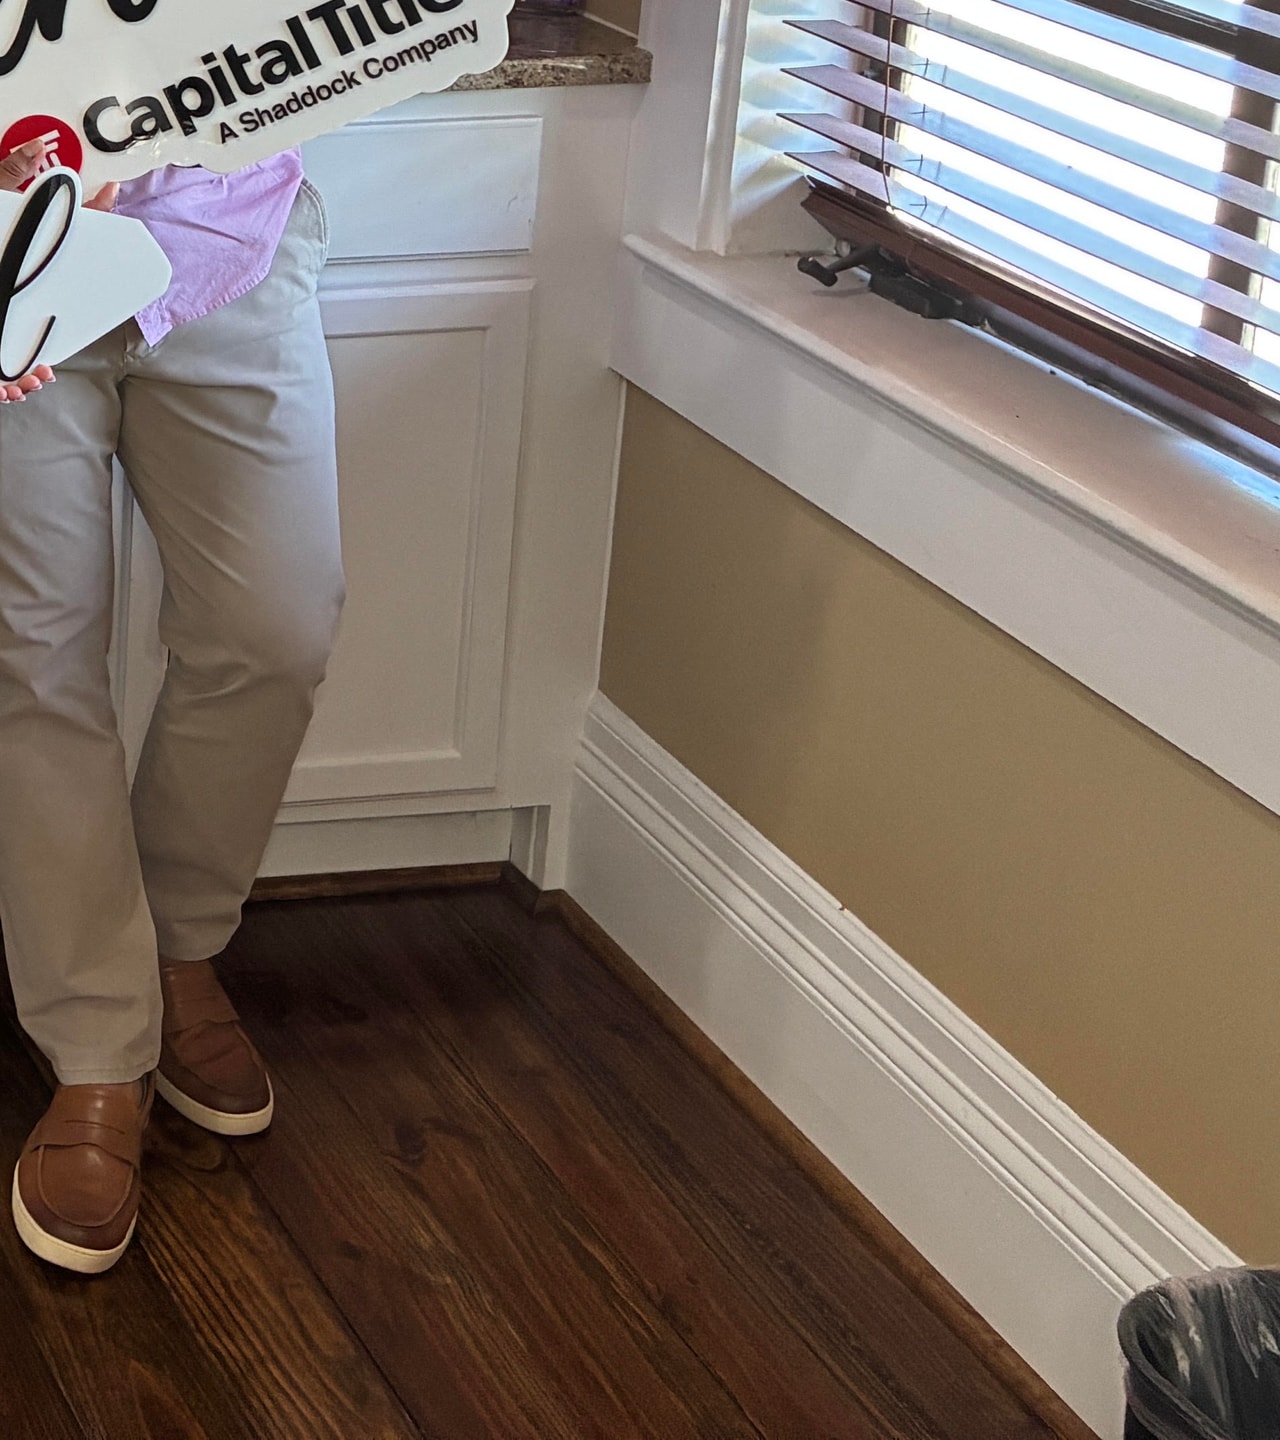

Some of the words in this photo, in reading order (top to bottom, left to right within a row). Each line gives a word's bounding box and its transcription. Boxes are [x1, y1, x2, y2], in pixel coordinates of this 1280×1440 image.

[219, 121, 239, 145] A
[239, 71, 361, 133] Shaddock
[362, 19, 479, 80] Company
